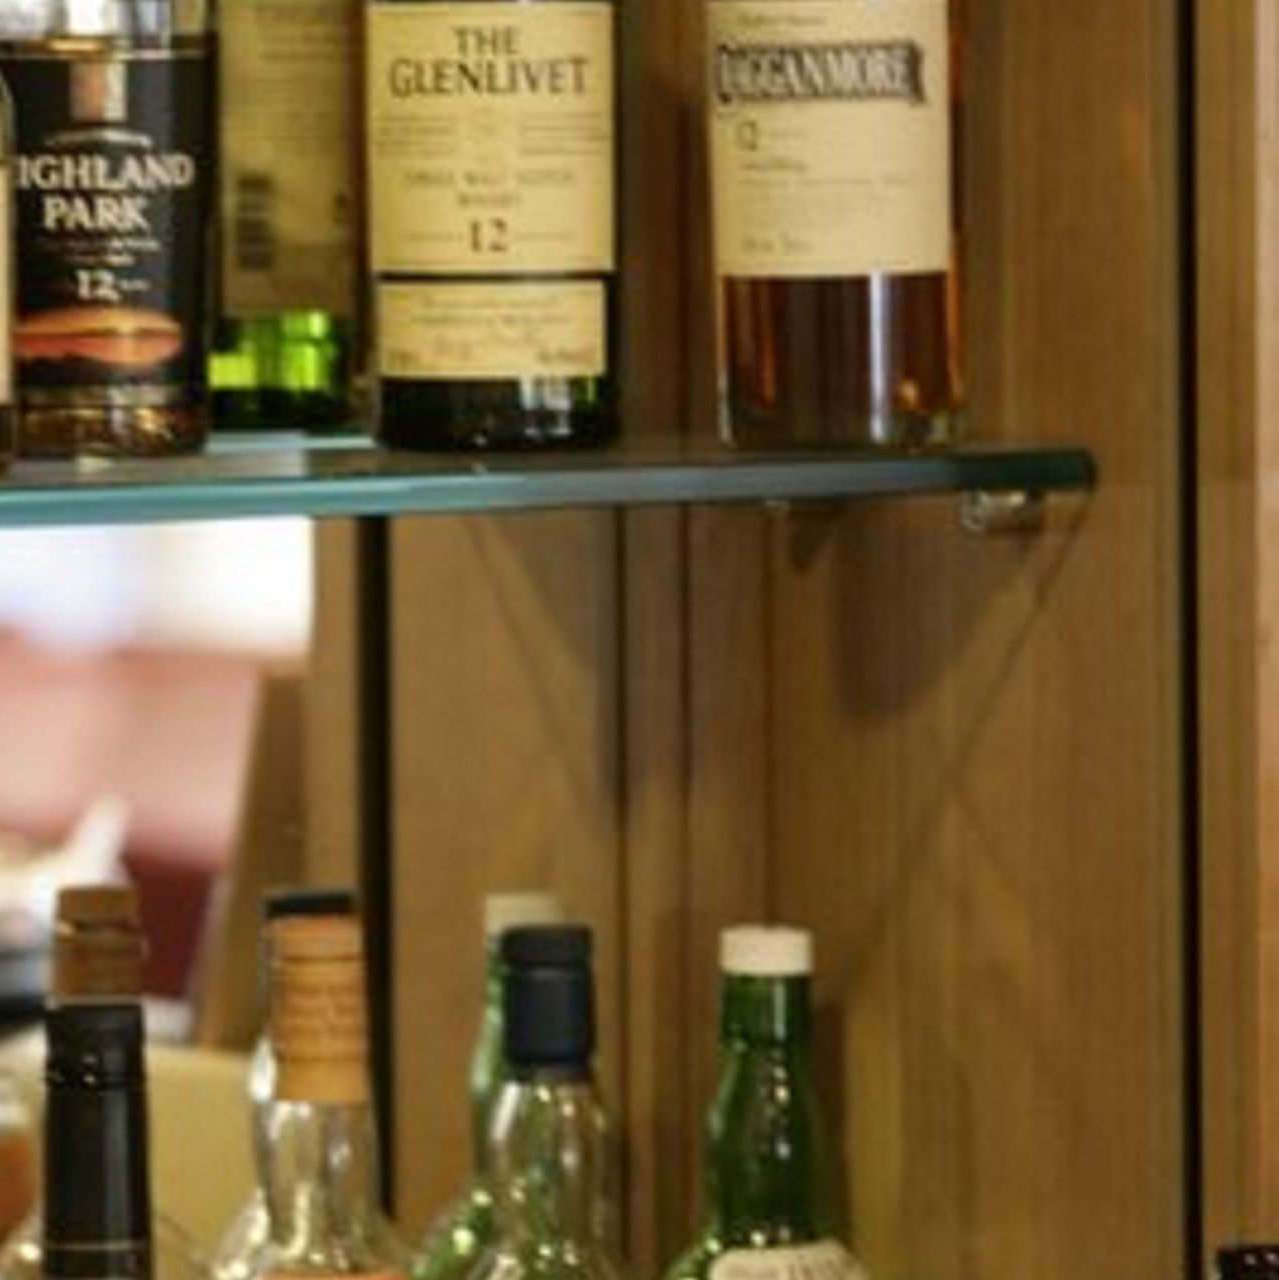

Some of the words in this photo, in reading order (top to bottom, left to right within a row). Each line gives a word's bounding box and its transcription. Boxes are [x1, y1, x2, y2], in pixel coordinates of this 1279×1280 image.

[453, 25, 520, 56] THE
[388, 57, 590, 99] GLENLIVET
[17, 153, 197, 191] IGHLAND
[42, 195, 152, 232] PARK
[469, 217, 509, 254] 12
[75, 269, 122, 301] 12
